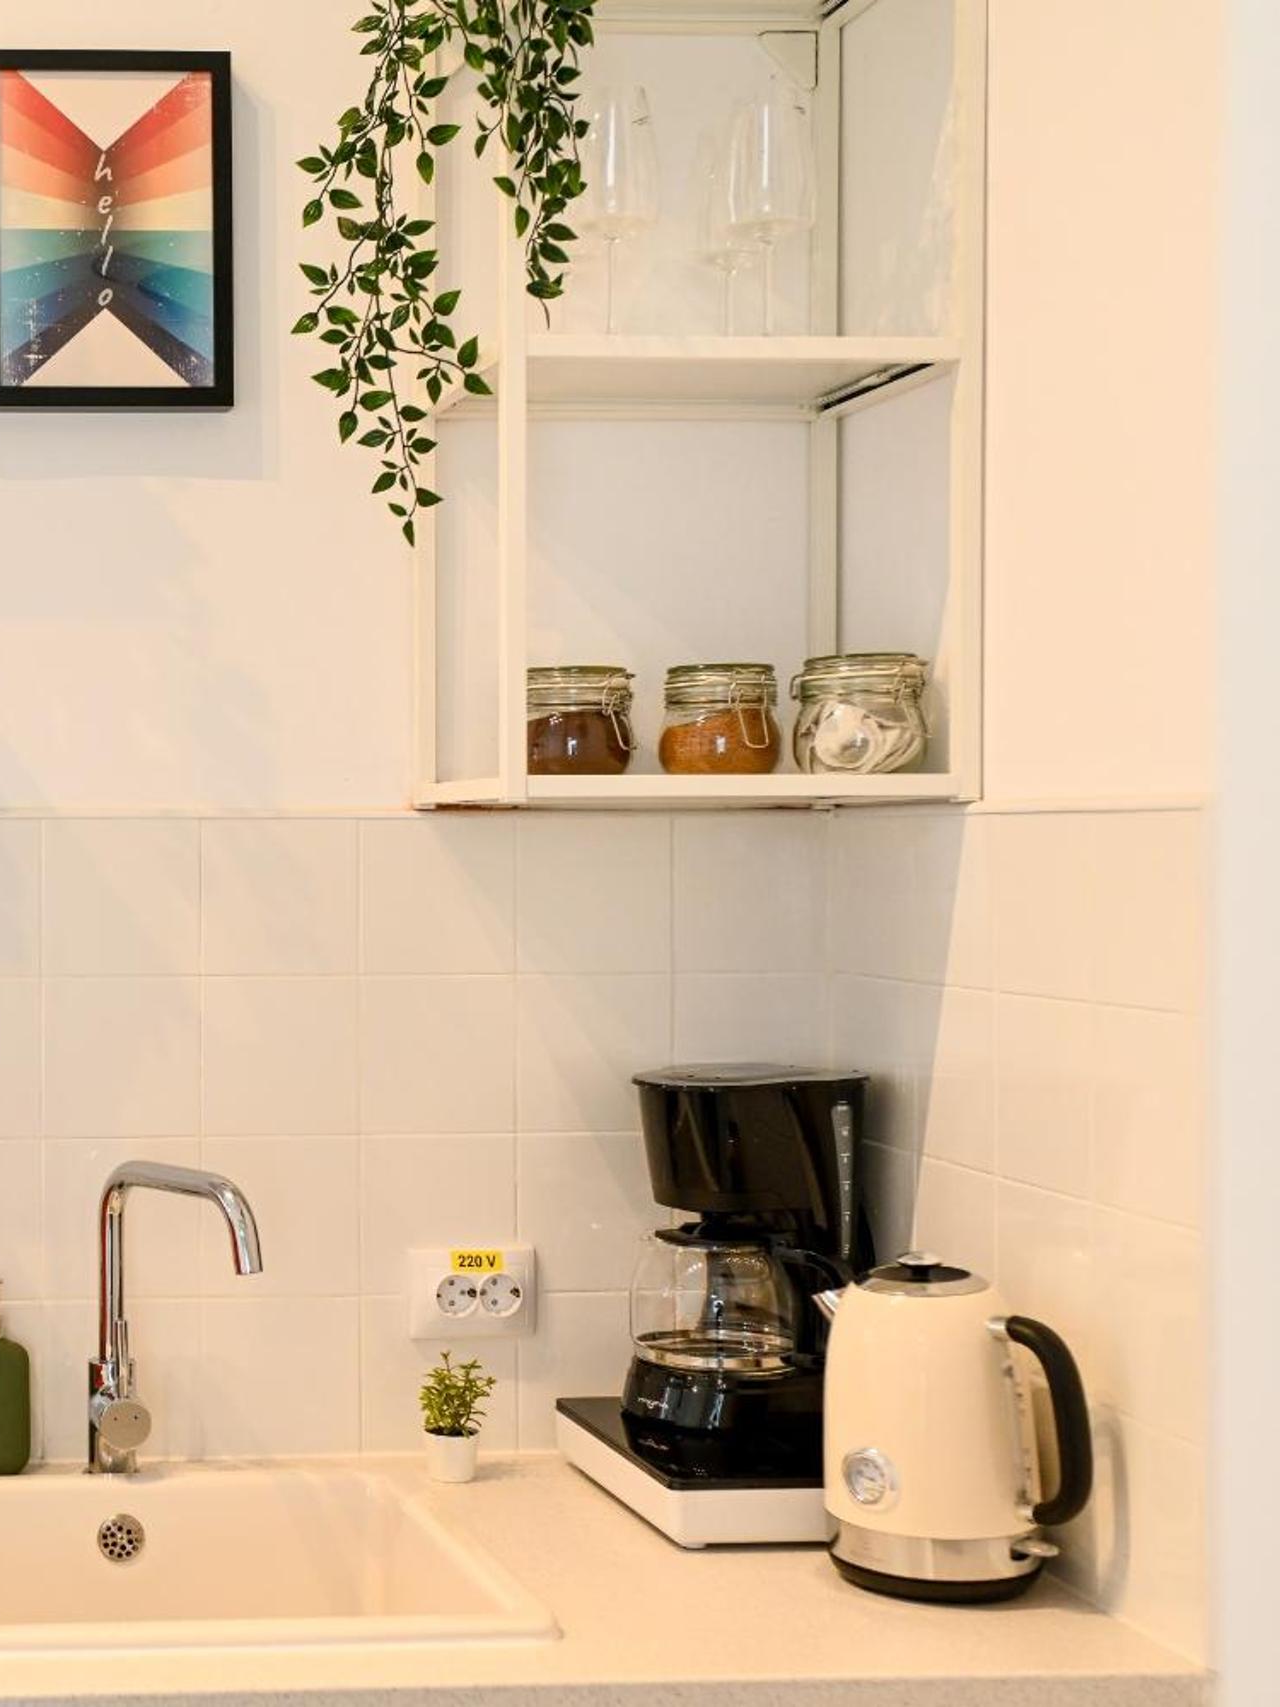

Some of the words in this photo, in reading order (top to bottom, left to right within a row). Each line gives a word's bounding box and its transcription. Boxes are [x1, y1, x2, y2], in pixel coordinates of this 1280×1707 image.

[93, 152, 114, 308] hello
[458, 1255, 482, 1268] 220
[486, 1255, 496, 1268] V
